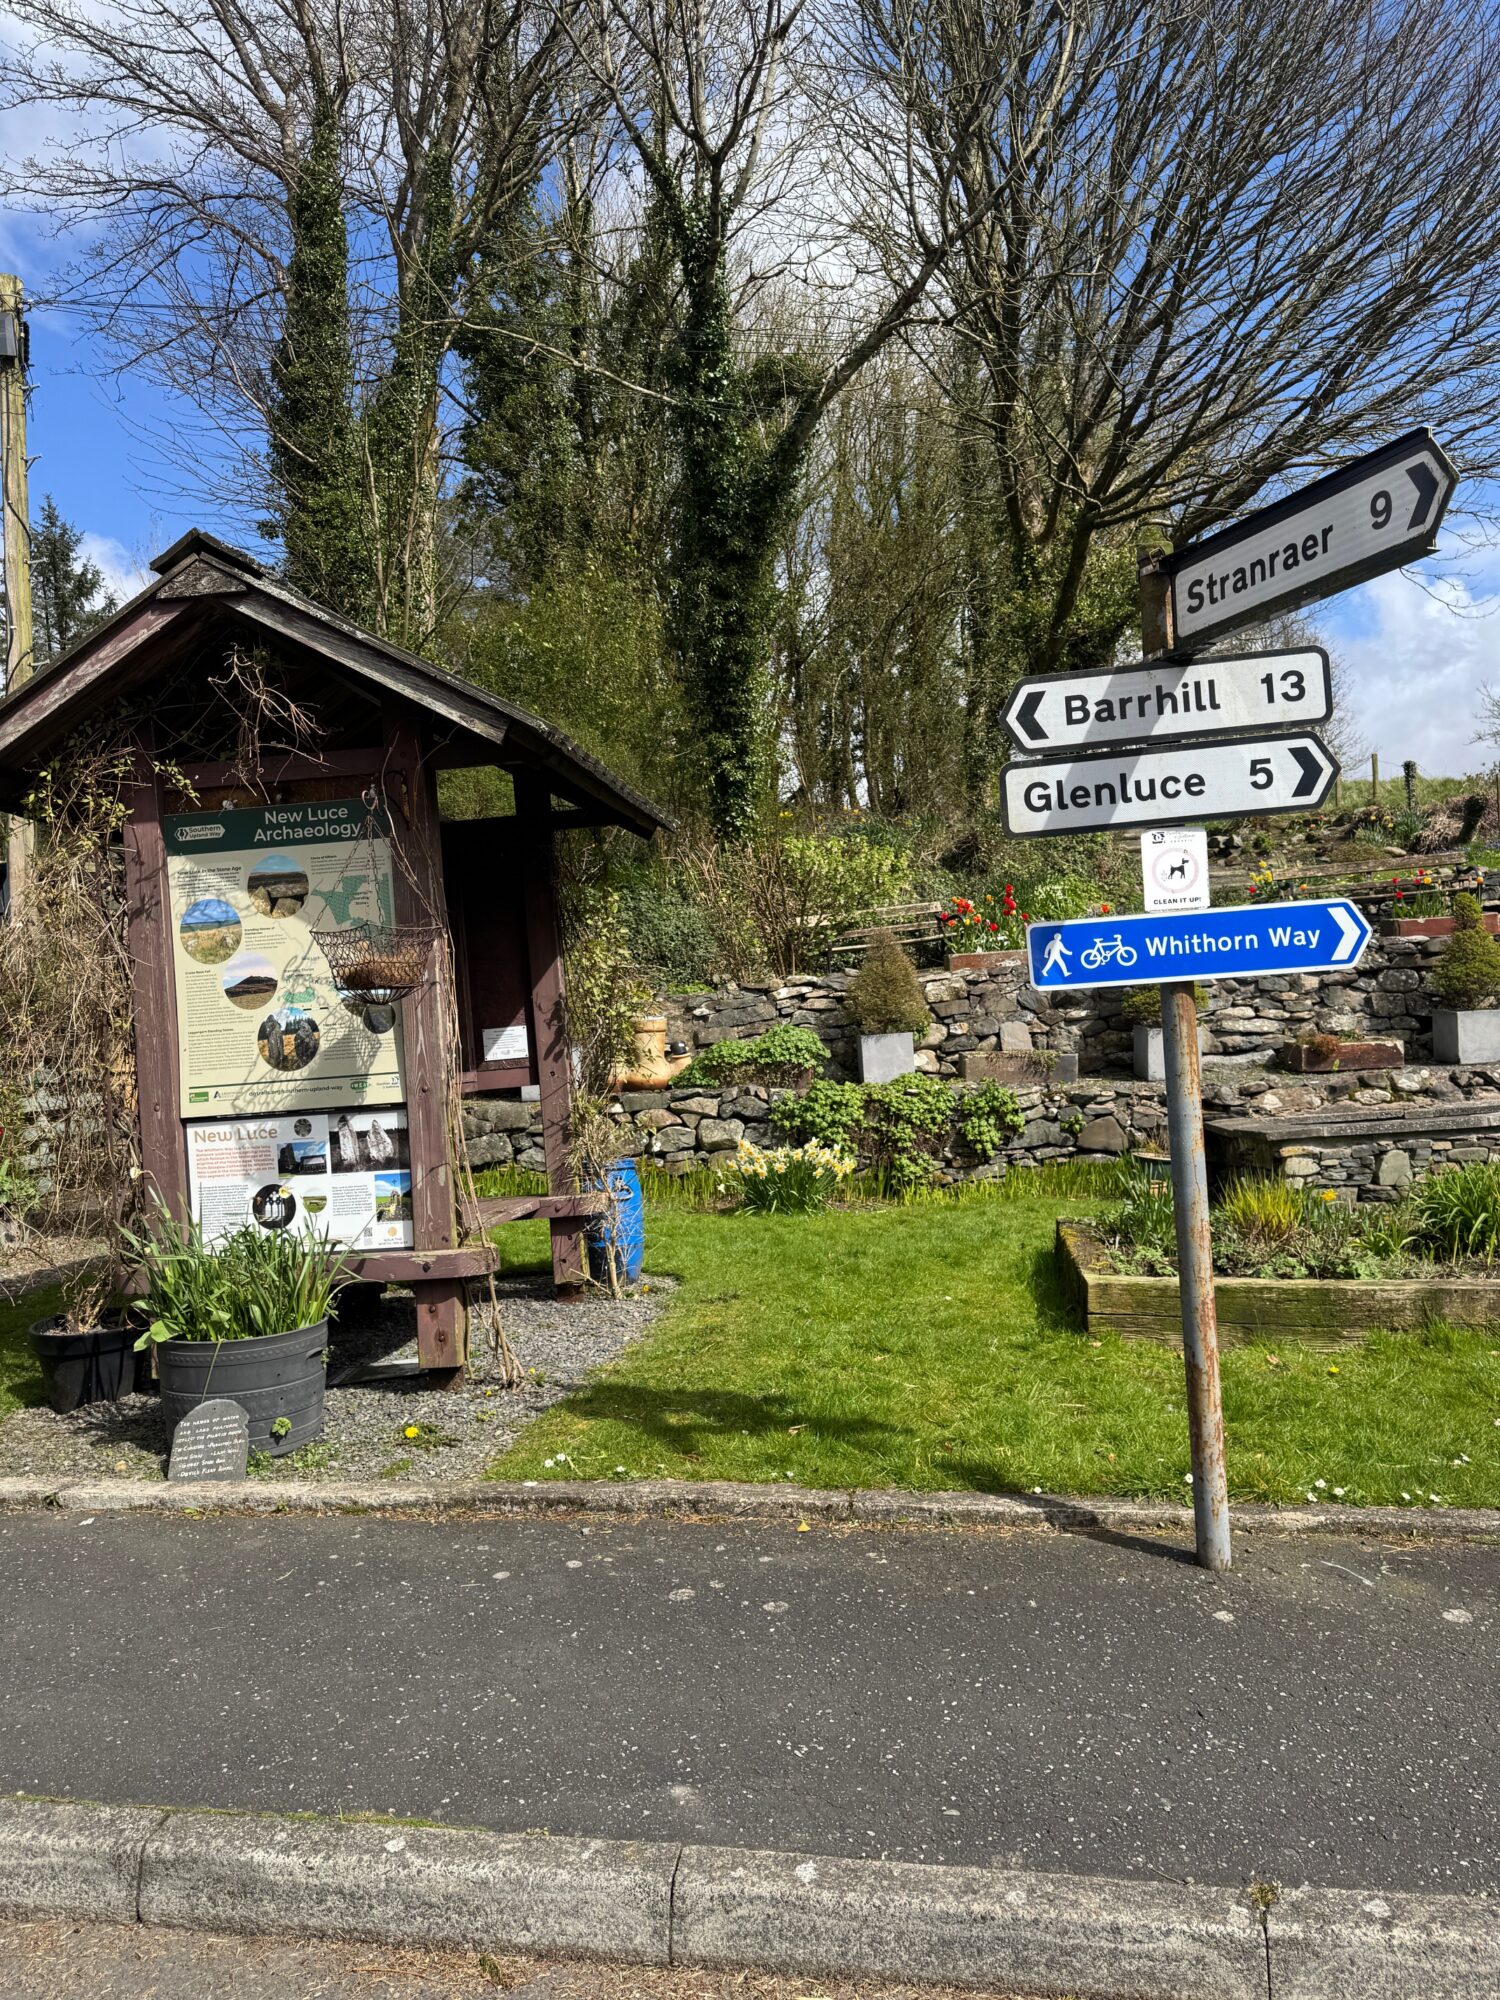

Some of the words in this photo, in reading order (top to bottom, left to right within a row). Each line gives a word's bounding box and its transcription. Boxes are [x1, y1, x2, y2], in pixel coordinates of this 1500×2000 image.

[1186, 523, 1334, 614] Stranraer
[1369, 489, 1393, 531] 9
[1064, 678, 1221, 726] Barrhill
[1260, 669, 1306, 704] 13
[1023, 772, 1206, 813] Glenluce
[1249, 757, 1274, 790] 5
[264, 810, 303, 825] New
[307, 806, 349, 821] Luce
[188, 825, 221, 834] Southern
[253, 821, 361, 842] Archaeology
[1153, 897, 1178, 905] CLEAN
[1145, 932, 1258, 957] Whithorn
[1268, 926, 1321, 948] Way
[194, 1129, 233, 1143] New
[237, 1127, 278, 1141] Luce
